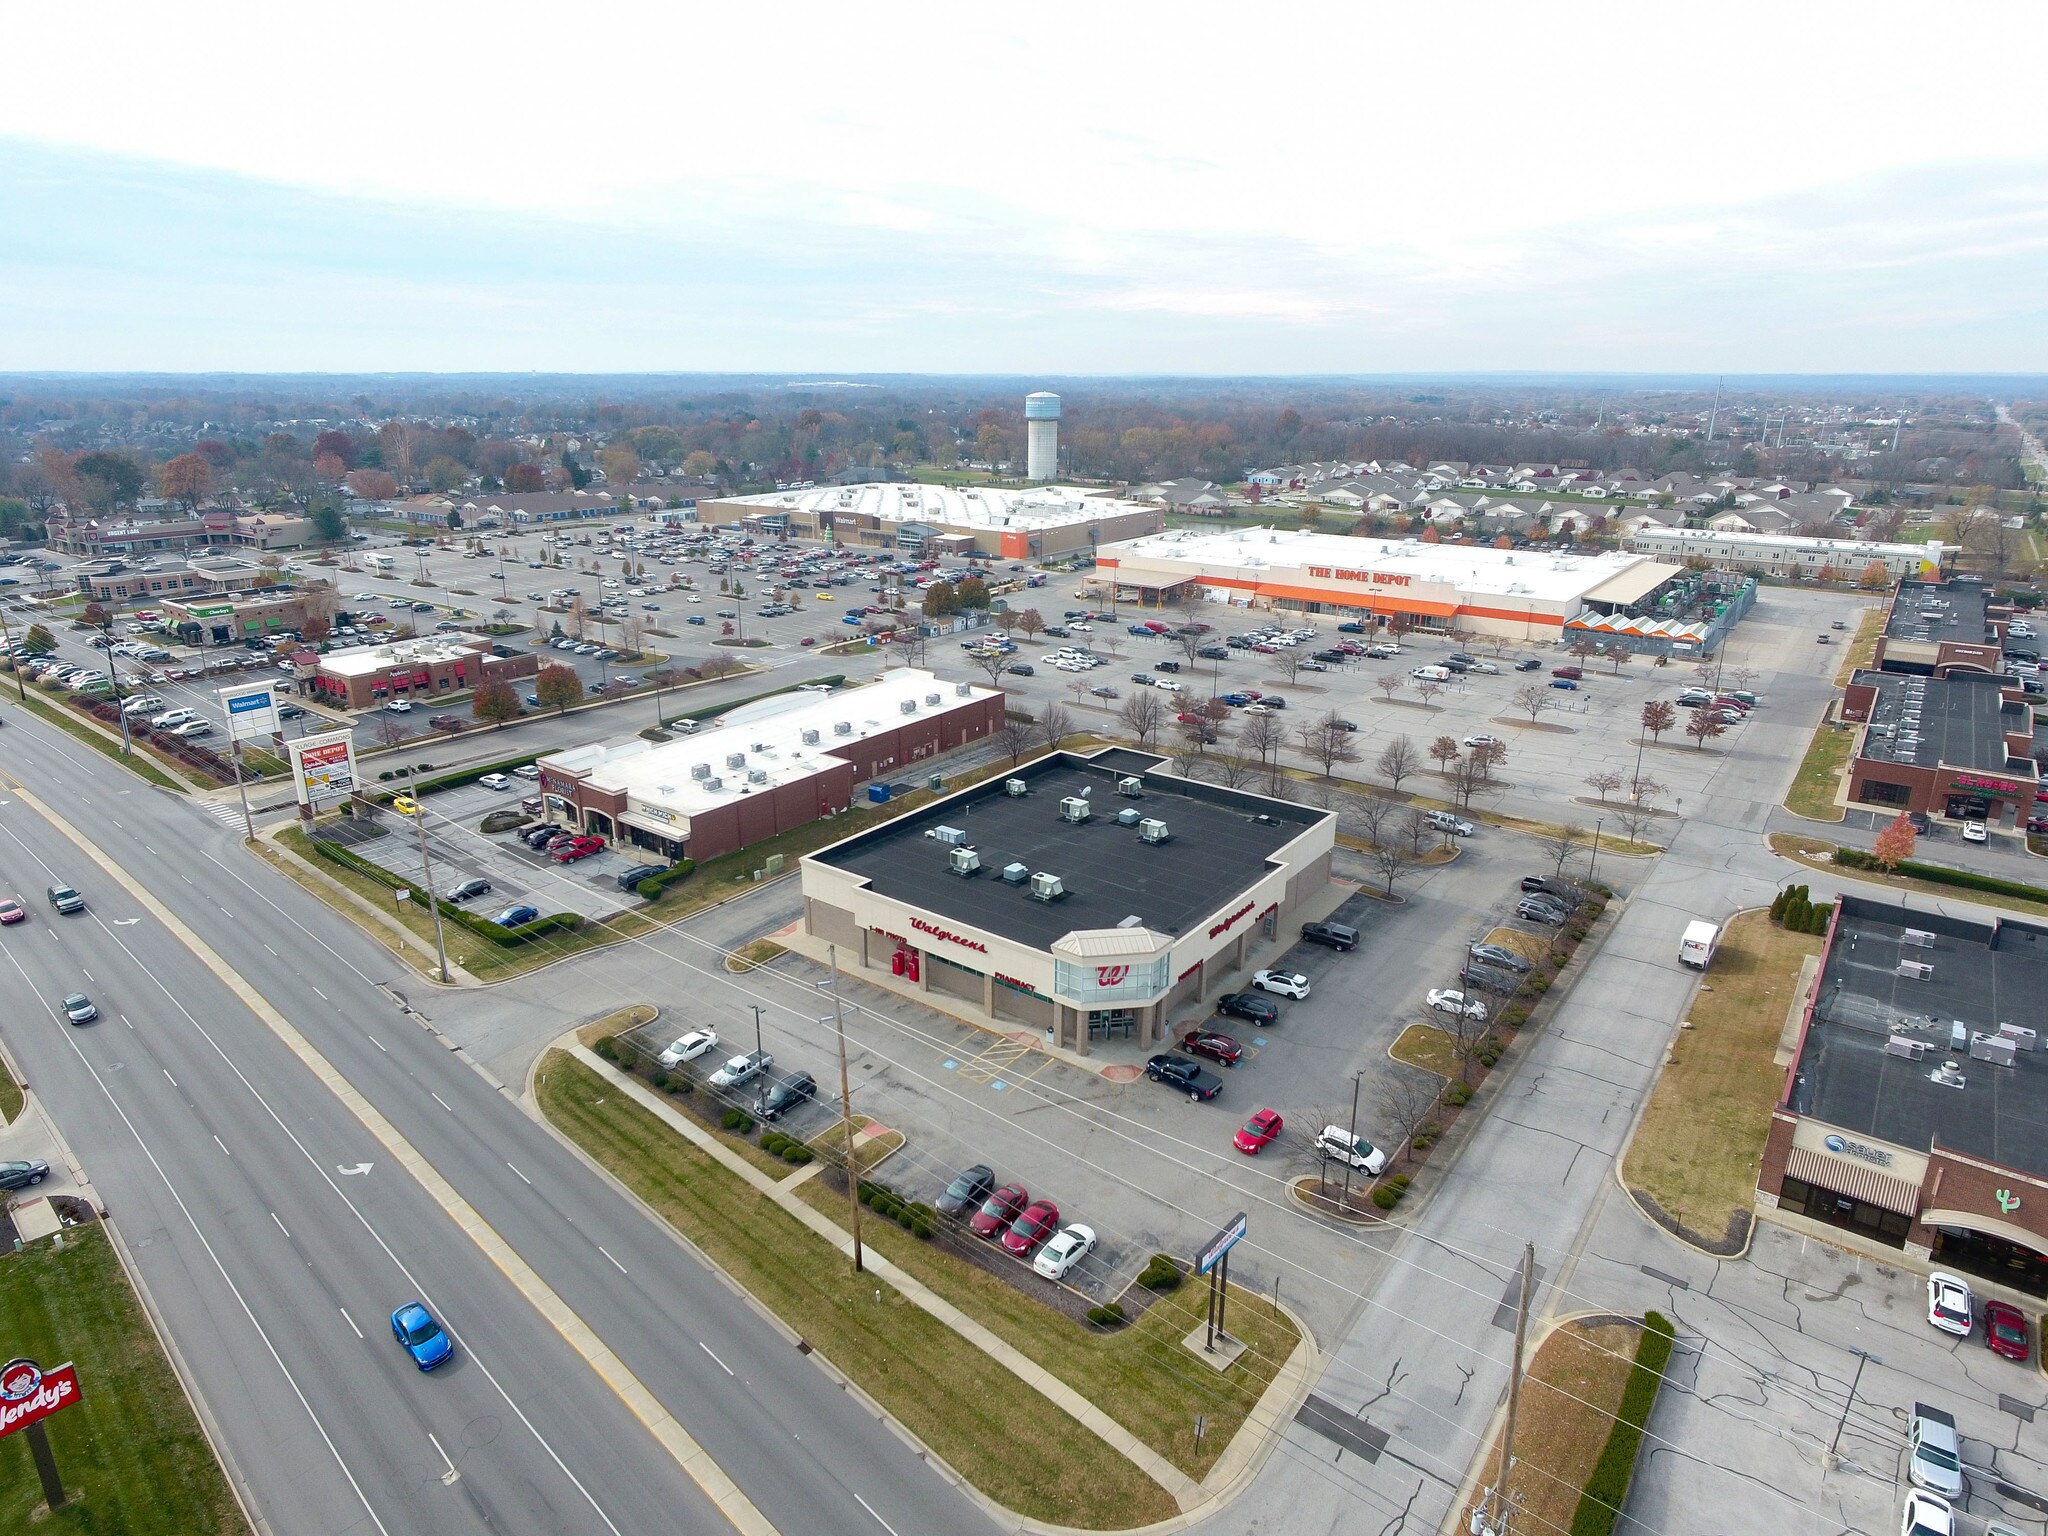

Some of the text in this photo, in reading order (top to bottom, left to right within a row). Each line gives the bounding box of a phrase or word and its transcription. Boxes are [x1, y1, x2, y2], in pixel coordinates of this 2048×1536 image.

[1308, 566, 1412, 587] THE HOME DEPOT
[231, 698, 260, 709] Walmart
[319, 733, 351, 745] COMMONS
[302, 745, 345, 760] HOME DEPOT
[1959, 774, 1975, 786] EL
[1976, 777, 2017, 793] RODEO
[869, 924, 907, 945] 1-HR PHOTO
[909, 917, 988, 954] Walgreens
[1684, 941, 1705, 952] FedEx
[994, 971, 1036, 992] PHARMACY
[1847, 1141, 1893, 1161] sauer
